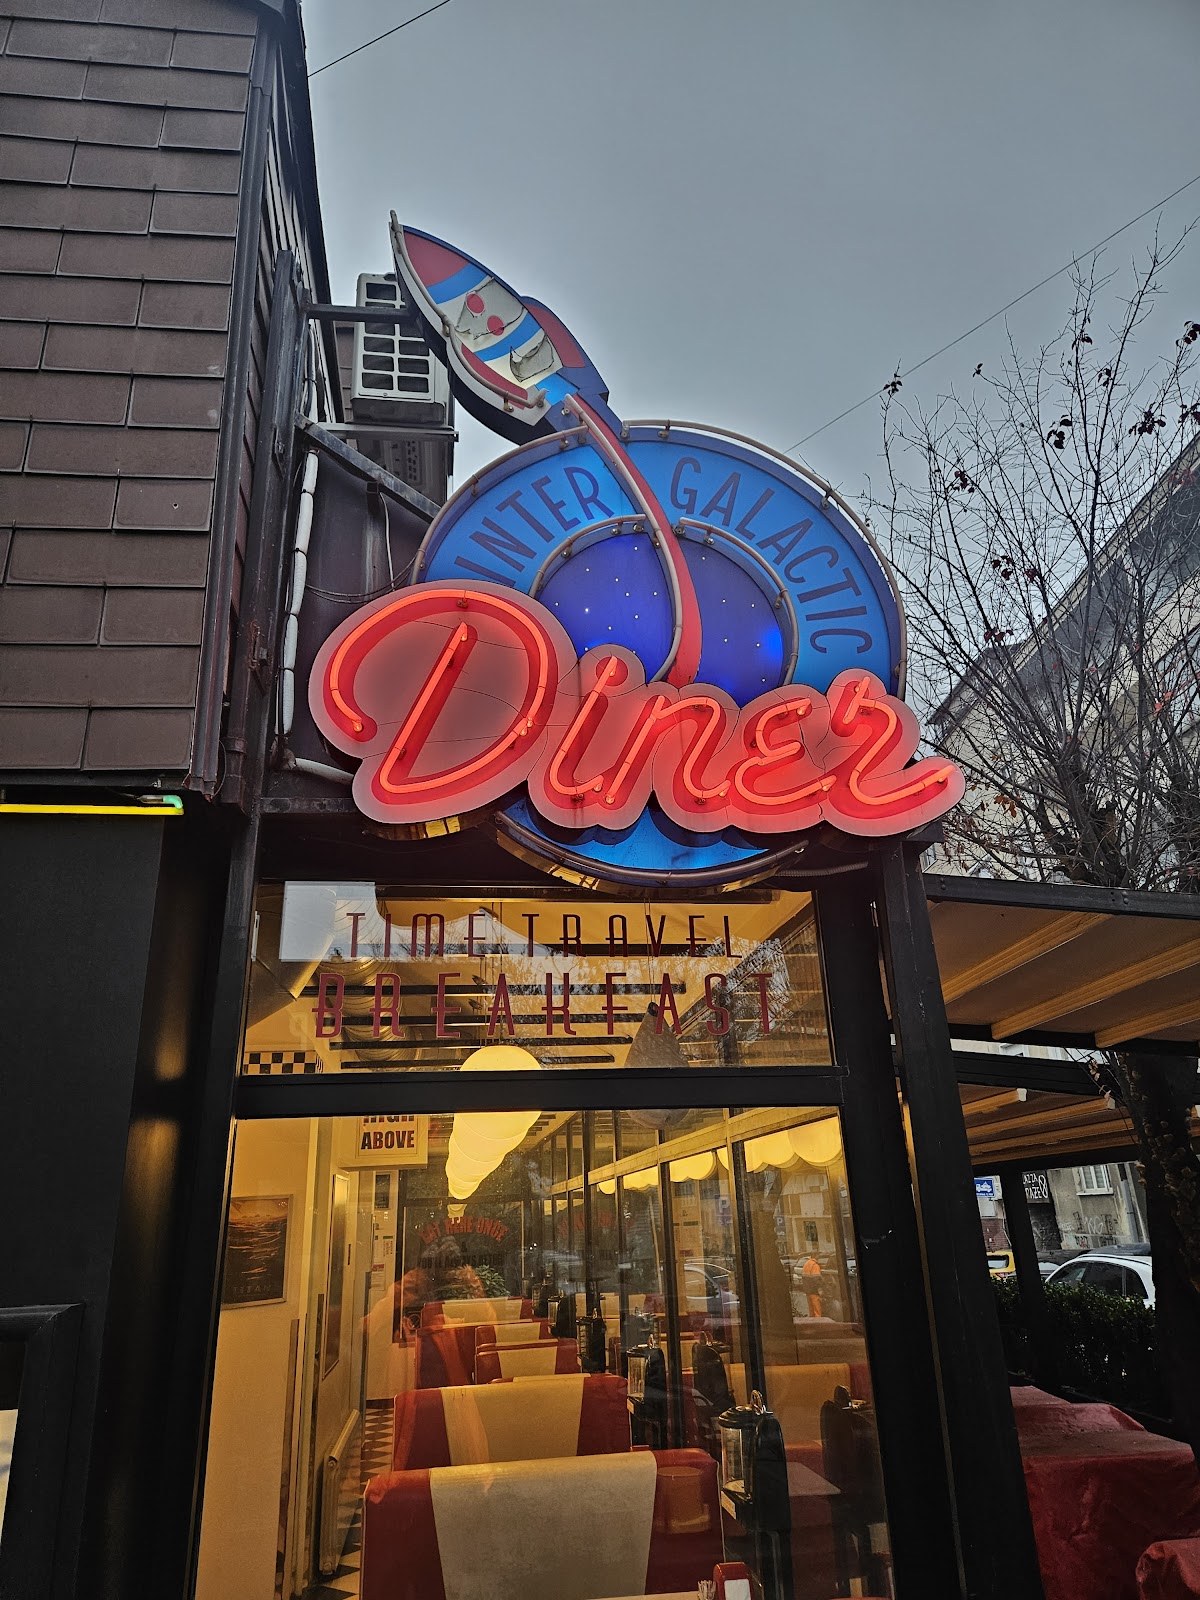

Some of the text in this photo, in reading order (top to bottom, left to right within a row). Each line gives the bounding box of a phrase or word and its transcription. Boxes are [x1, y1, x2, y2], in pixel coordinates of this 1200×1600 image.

[454, 457, 873, 653] INTER GALACTIC
[322, 588, 957, 823] Diner
[346, 912, 742, 959] TIME TRAVEL
[311, 972, 772, 1038] BREAKFAST
[361, 1130, 414, 1150] ABOVE
[719, 1196, 730, 1213] P
